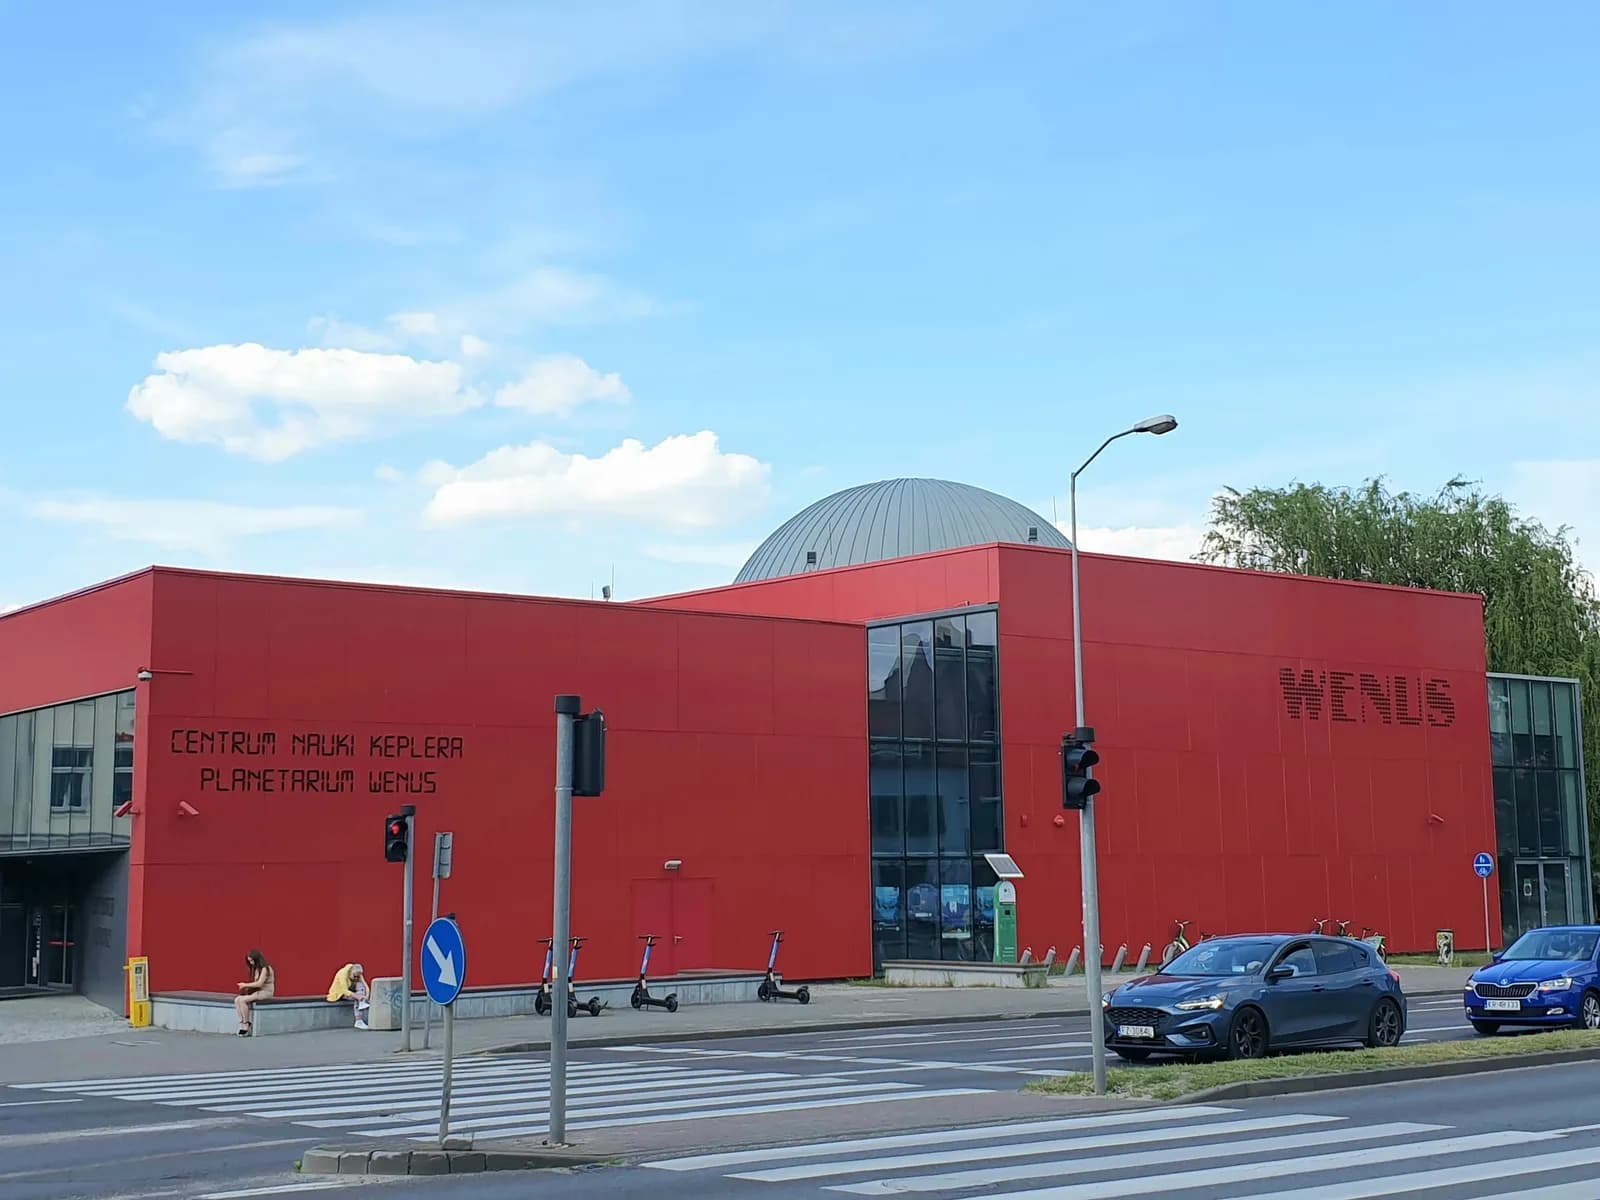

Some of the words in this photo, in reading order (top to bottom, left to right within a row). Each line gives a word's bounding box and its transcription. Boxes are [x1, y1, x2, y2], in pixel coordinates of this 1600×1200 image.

[1280, 667, 1455, 727] WENUS
[171, 729, 276, 755] CENTRUM
[292, 733, 355, 757] NAUKI
[369, 735, 463, 759] KEPLERA
[200, 767, 354, 793] PLANETARIUM
[368, 771, 437, 793] WENUS
